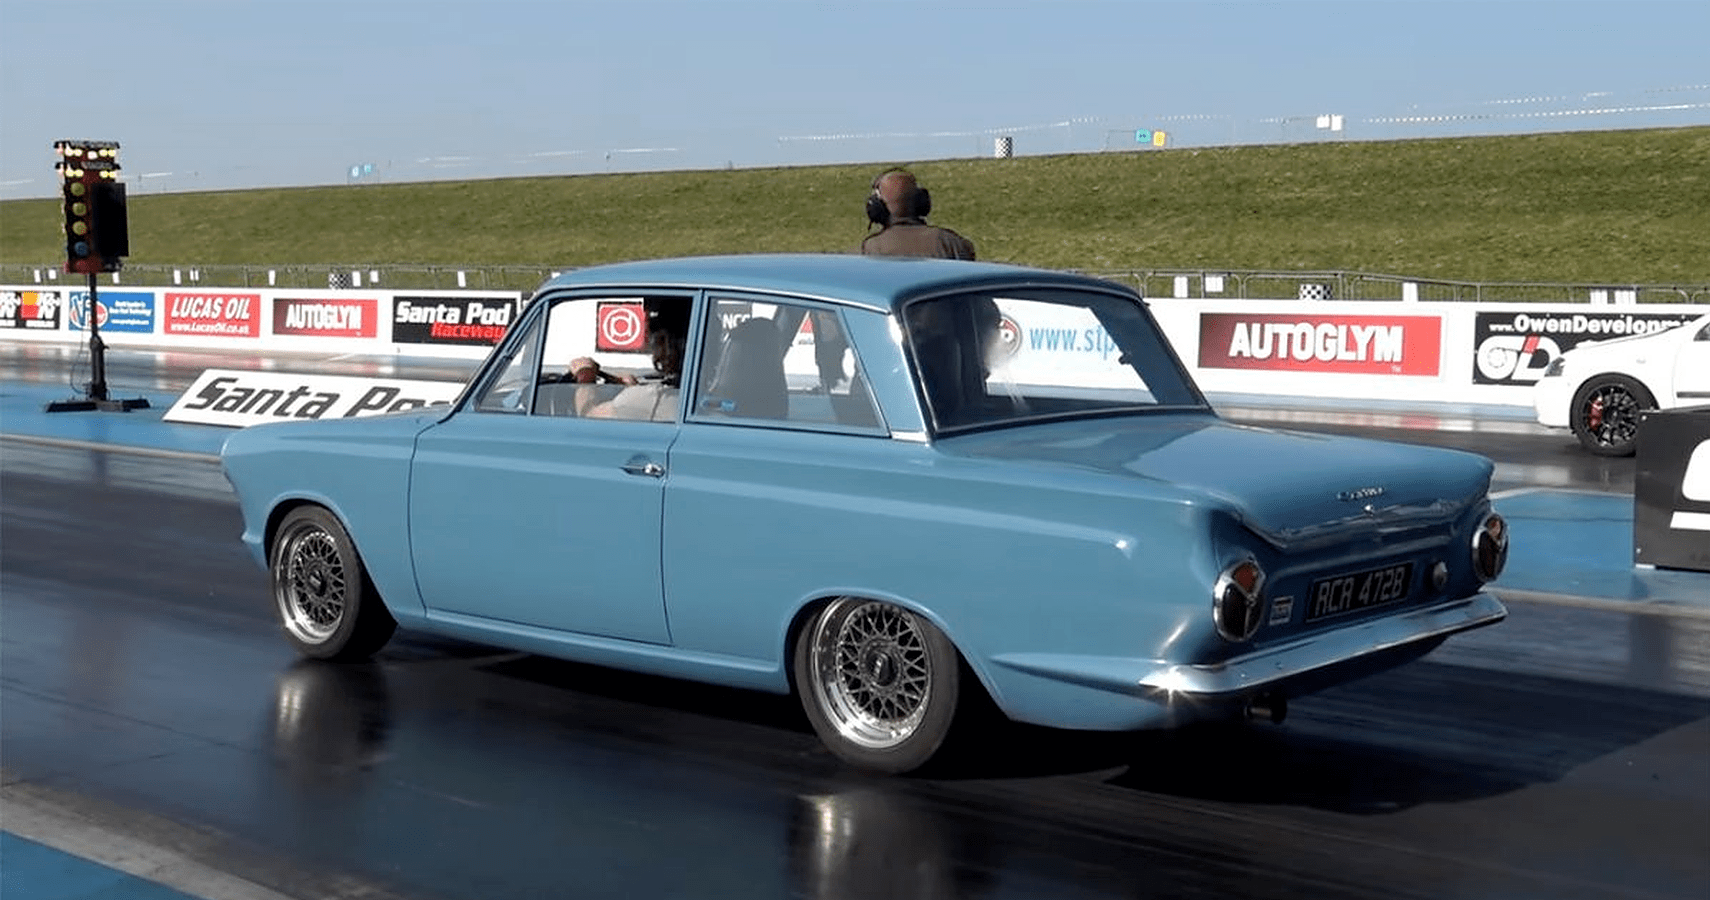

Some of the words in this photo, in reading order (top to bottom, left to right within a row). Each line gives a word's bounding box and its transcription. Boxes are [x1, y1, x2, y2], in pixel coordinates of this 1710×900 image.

[170, 297, 223, 319] LUCAS
[225, 298, 251, 320] OIL
[285, 304, 362, 330] AUTOGLYM
[396, 301, 461, 324] Santa
[466, 302, 510, 326] Pod
[1228, 322, 1404, 363] AUTOGLYM
[183, 376, 341, 419] Santa
